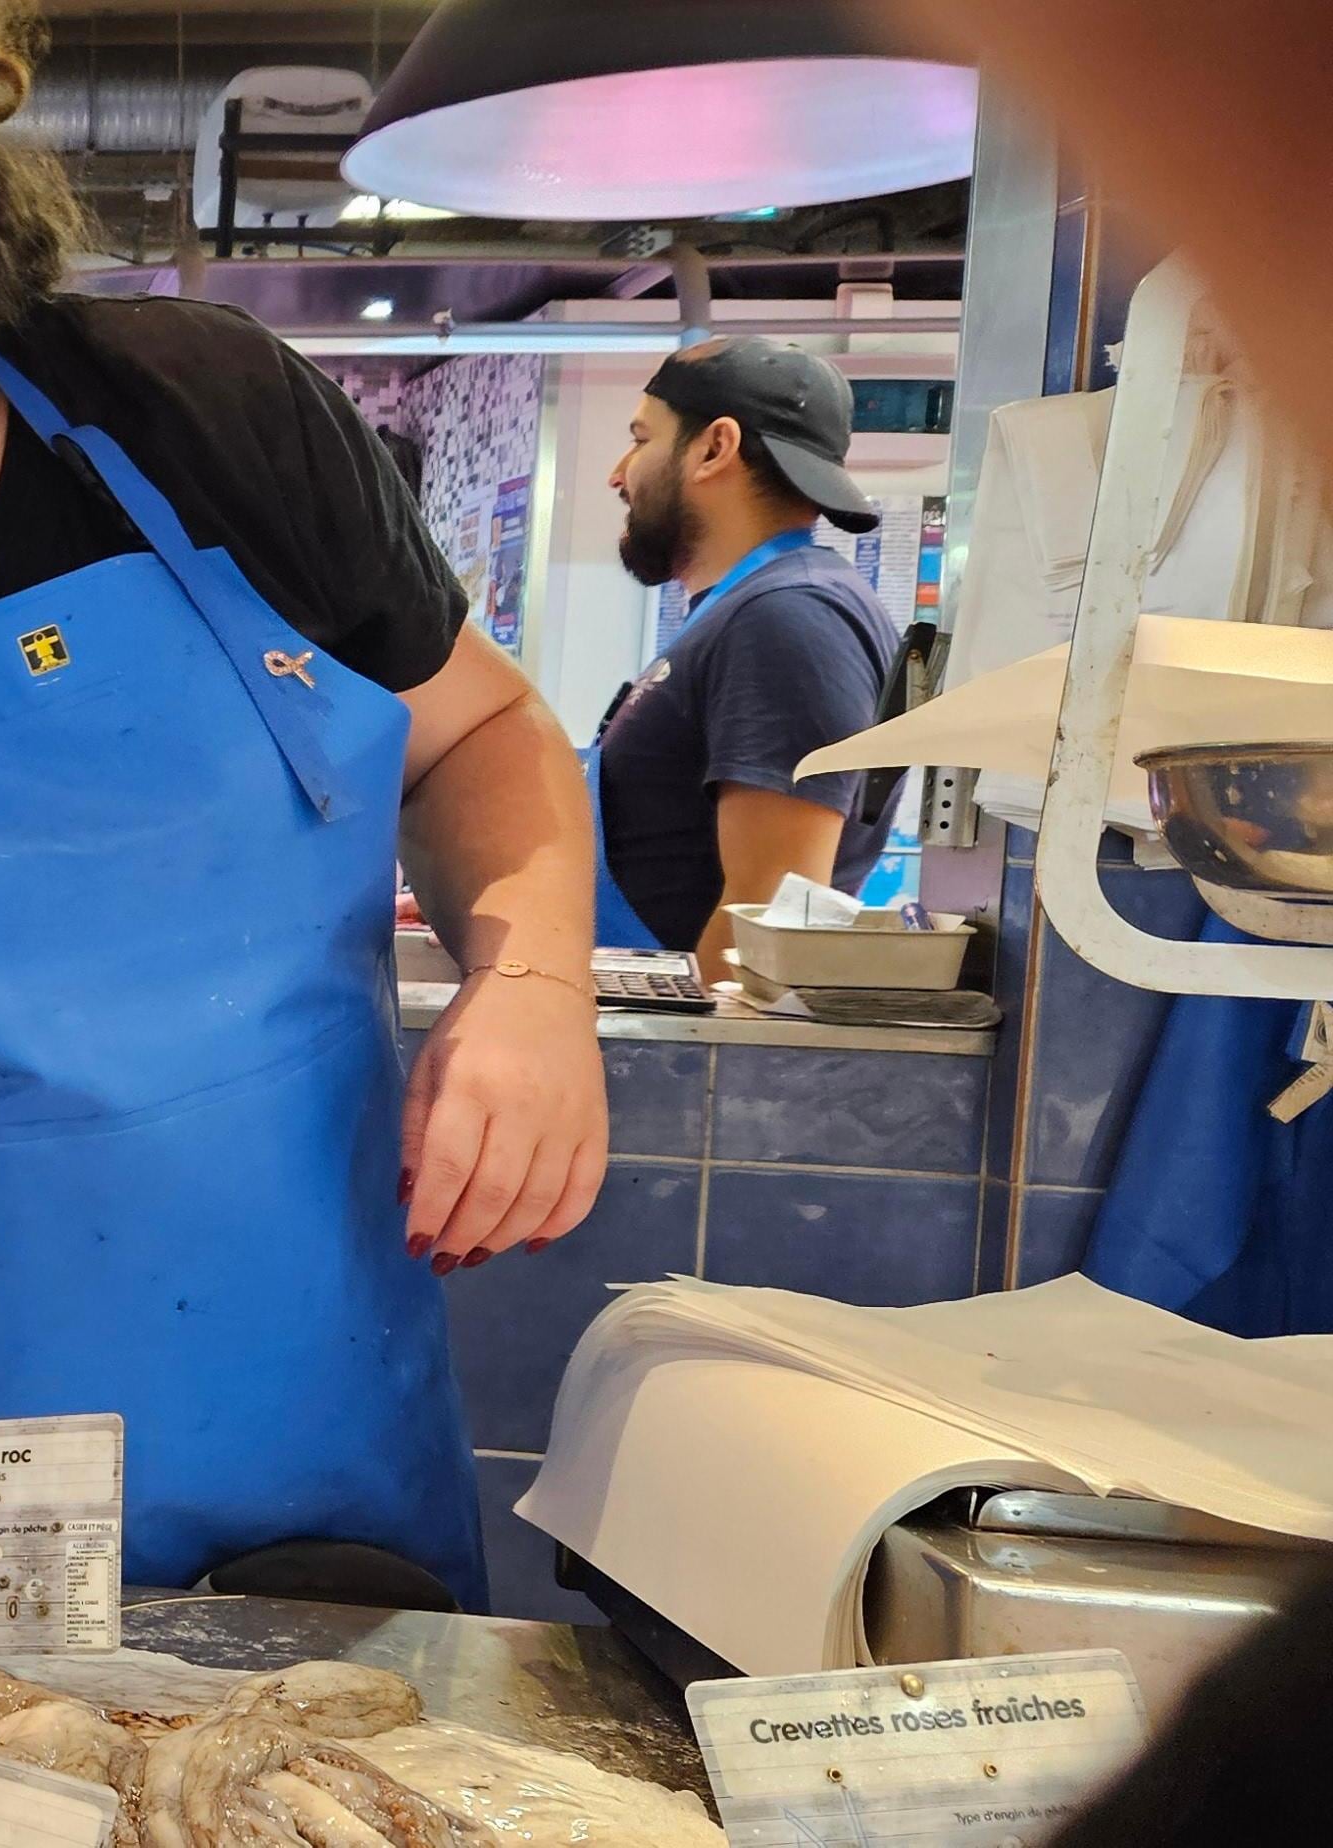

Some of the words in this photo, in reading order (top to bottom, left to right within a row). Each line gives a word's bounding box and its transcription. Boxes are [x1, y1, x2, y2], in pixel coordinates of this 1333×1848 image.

[1, 1449, 32, 1464] roc
[12, 1526, 21, 1534] de
[23, 1525, 47, 1535] pêche
[750, 1712, 884, 1745] Crevettes
[890, 1705, 967, 1734] roses
[973, 1694, 1086, 1726] fraîches
[954, 1812, 981, 1825] Type
[984, 1809, 1025, 1822] d'engin
